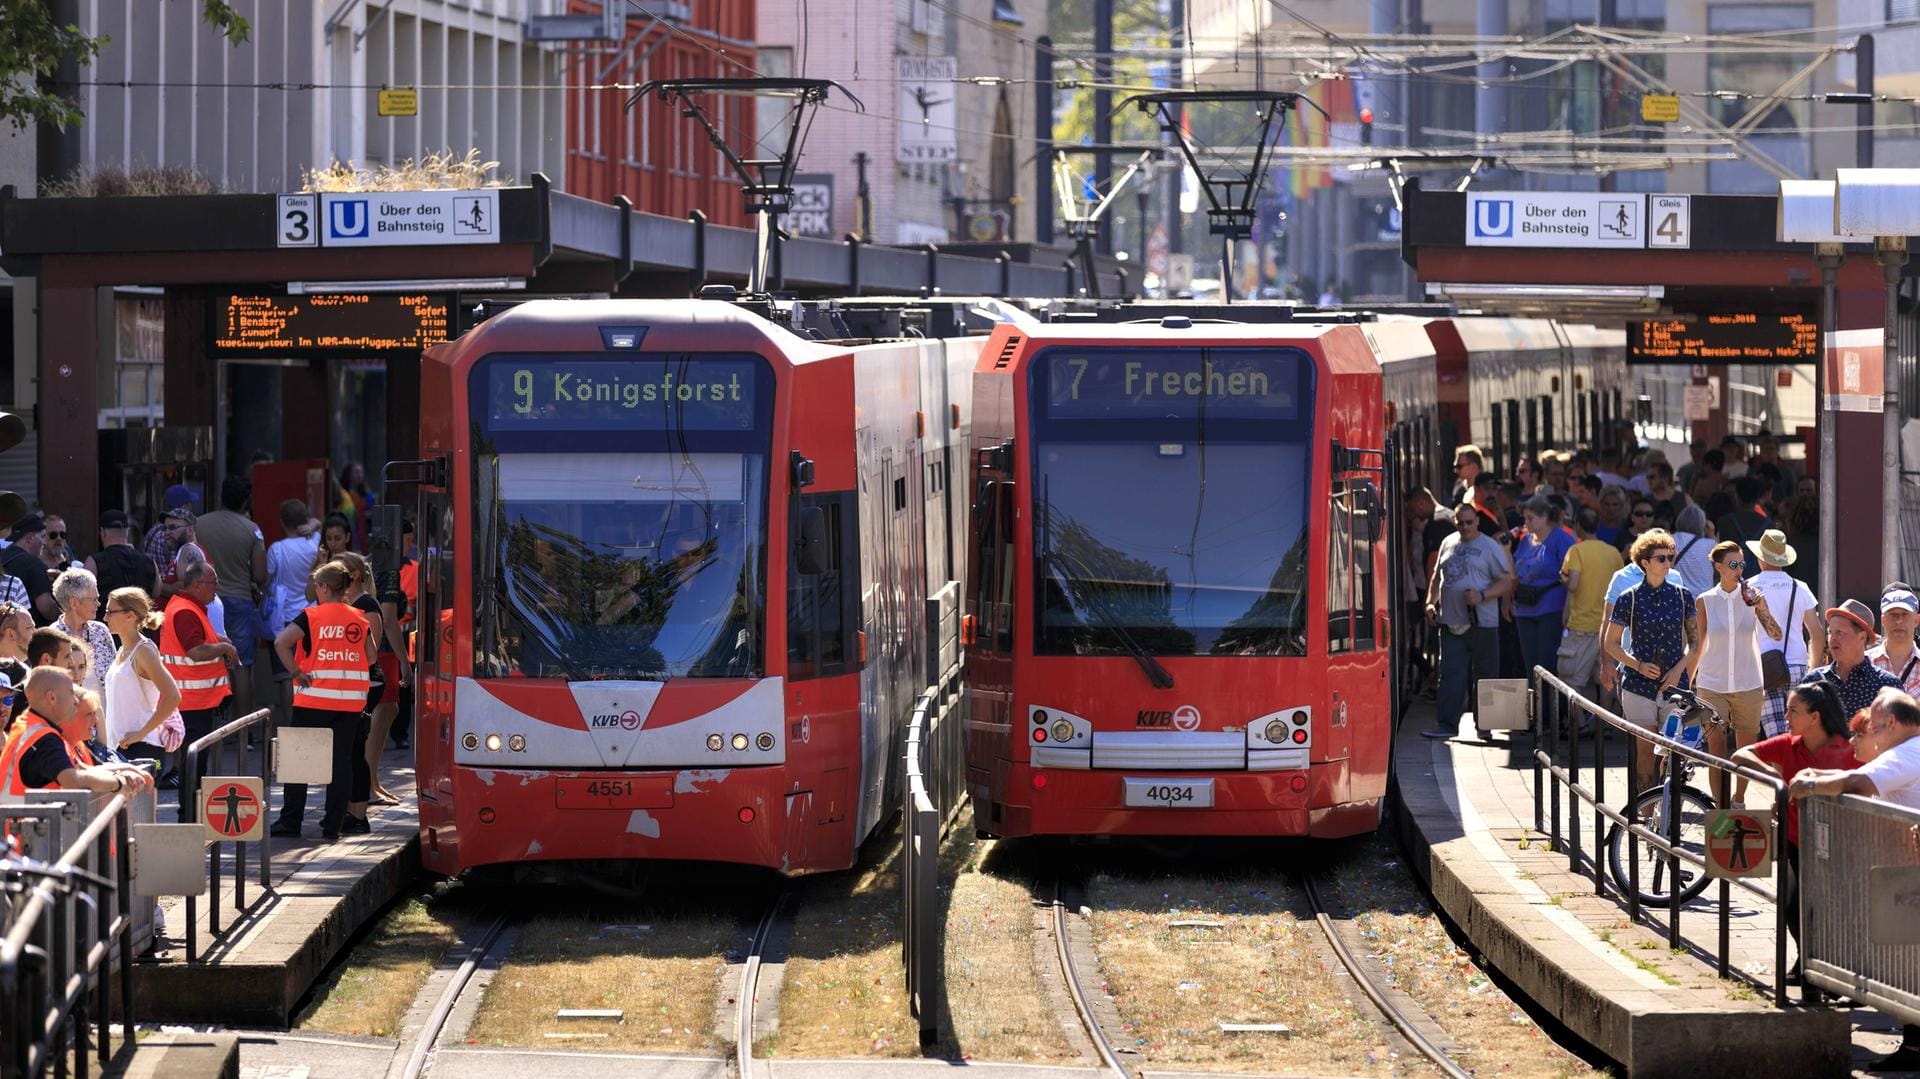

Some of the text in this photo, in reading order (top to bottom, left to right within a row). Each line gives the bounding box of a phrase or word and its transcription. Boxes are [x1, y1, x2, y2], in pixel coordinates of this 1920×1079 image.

[286, 198, 308, 207] Gleis
[380, 202, 441, 216] Über den
[1525, 203, 1586, 217] Über den
[1659, 199, 1681, 208] Gleis
[285, 210, 310, 241] 3
[333, 202, 365, 236] U
[1478, 202, 1510, 235] U
[377, 220, 445, 233] Bahnsteig
[1522, 221, 1589, 236] Bahnsteig
[1656, 212, 1683, 243] 4
[414, 305, 447, 317] Sofort
[229, 316, 235, 326] 1
[1069, 359, 1268, 400] 7 Frechen
[514, 369, 740, 413] 9 Königsforst
[318, 625, 345, 640] KVB
[317, 648, 360, 662] Service
[592, 715, 620, 727] KVB
[1136, 711, 1173, 726] KVB
[586, 781, 632, 796] 4551
[1146, 786, 1194, 802] 4034
